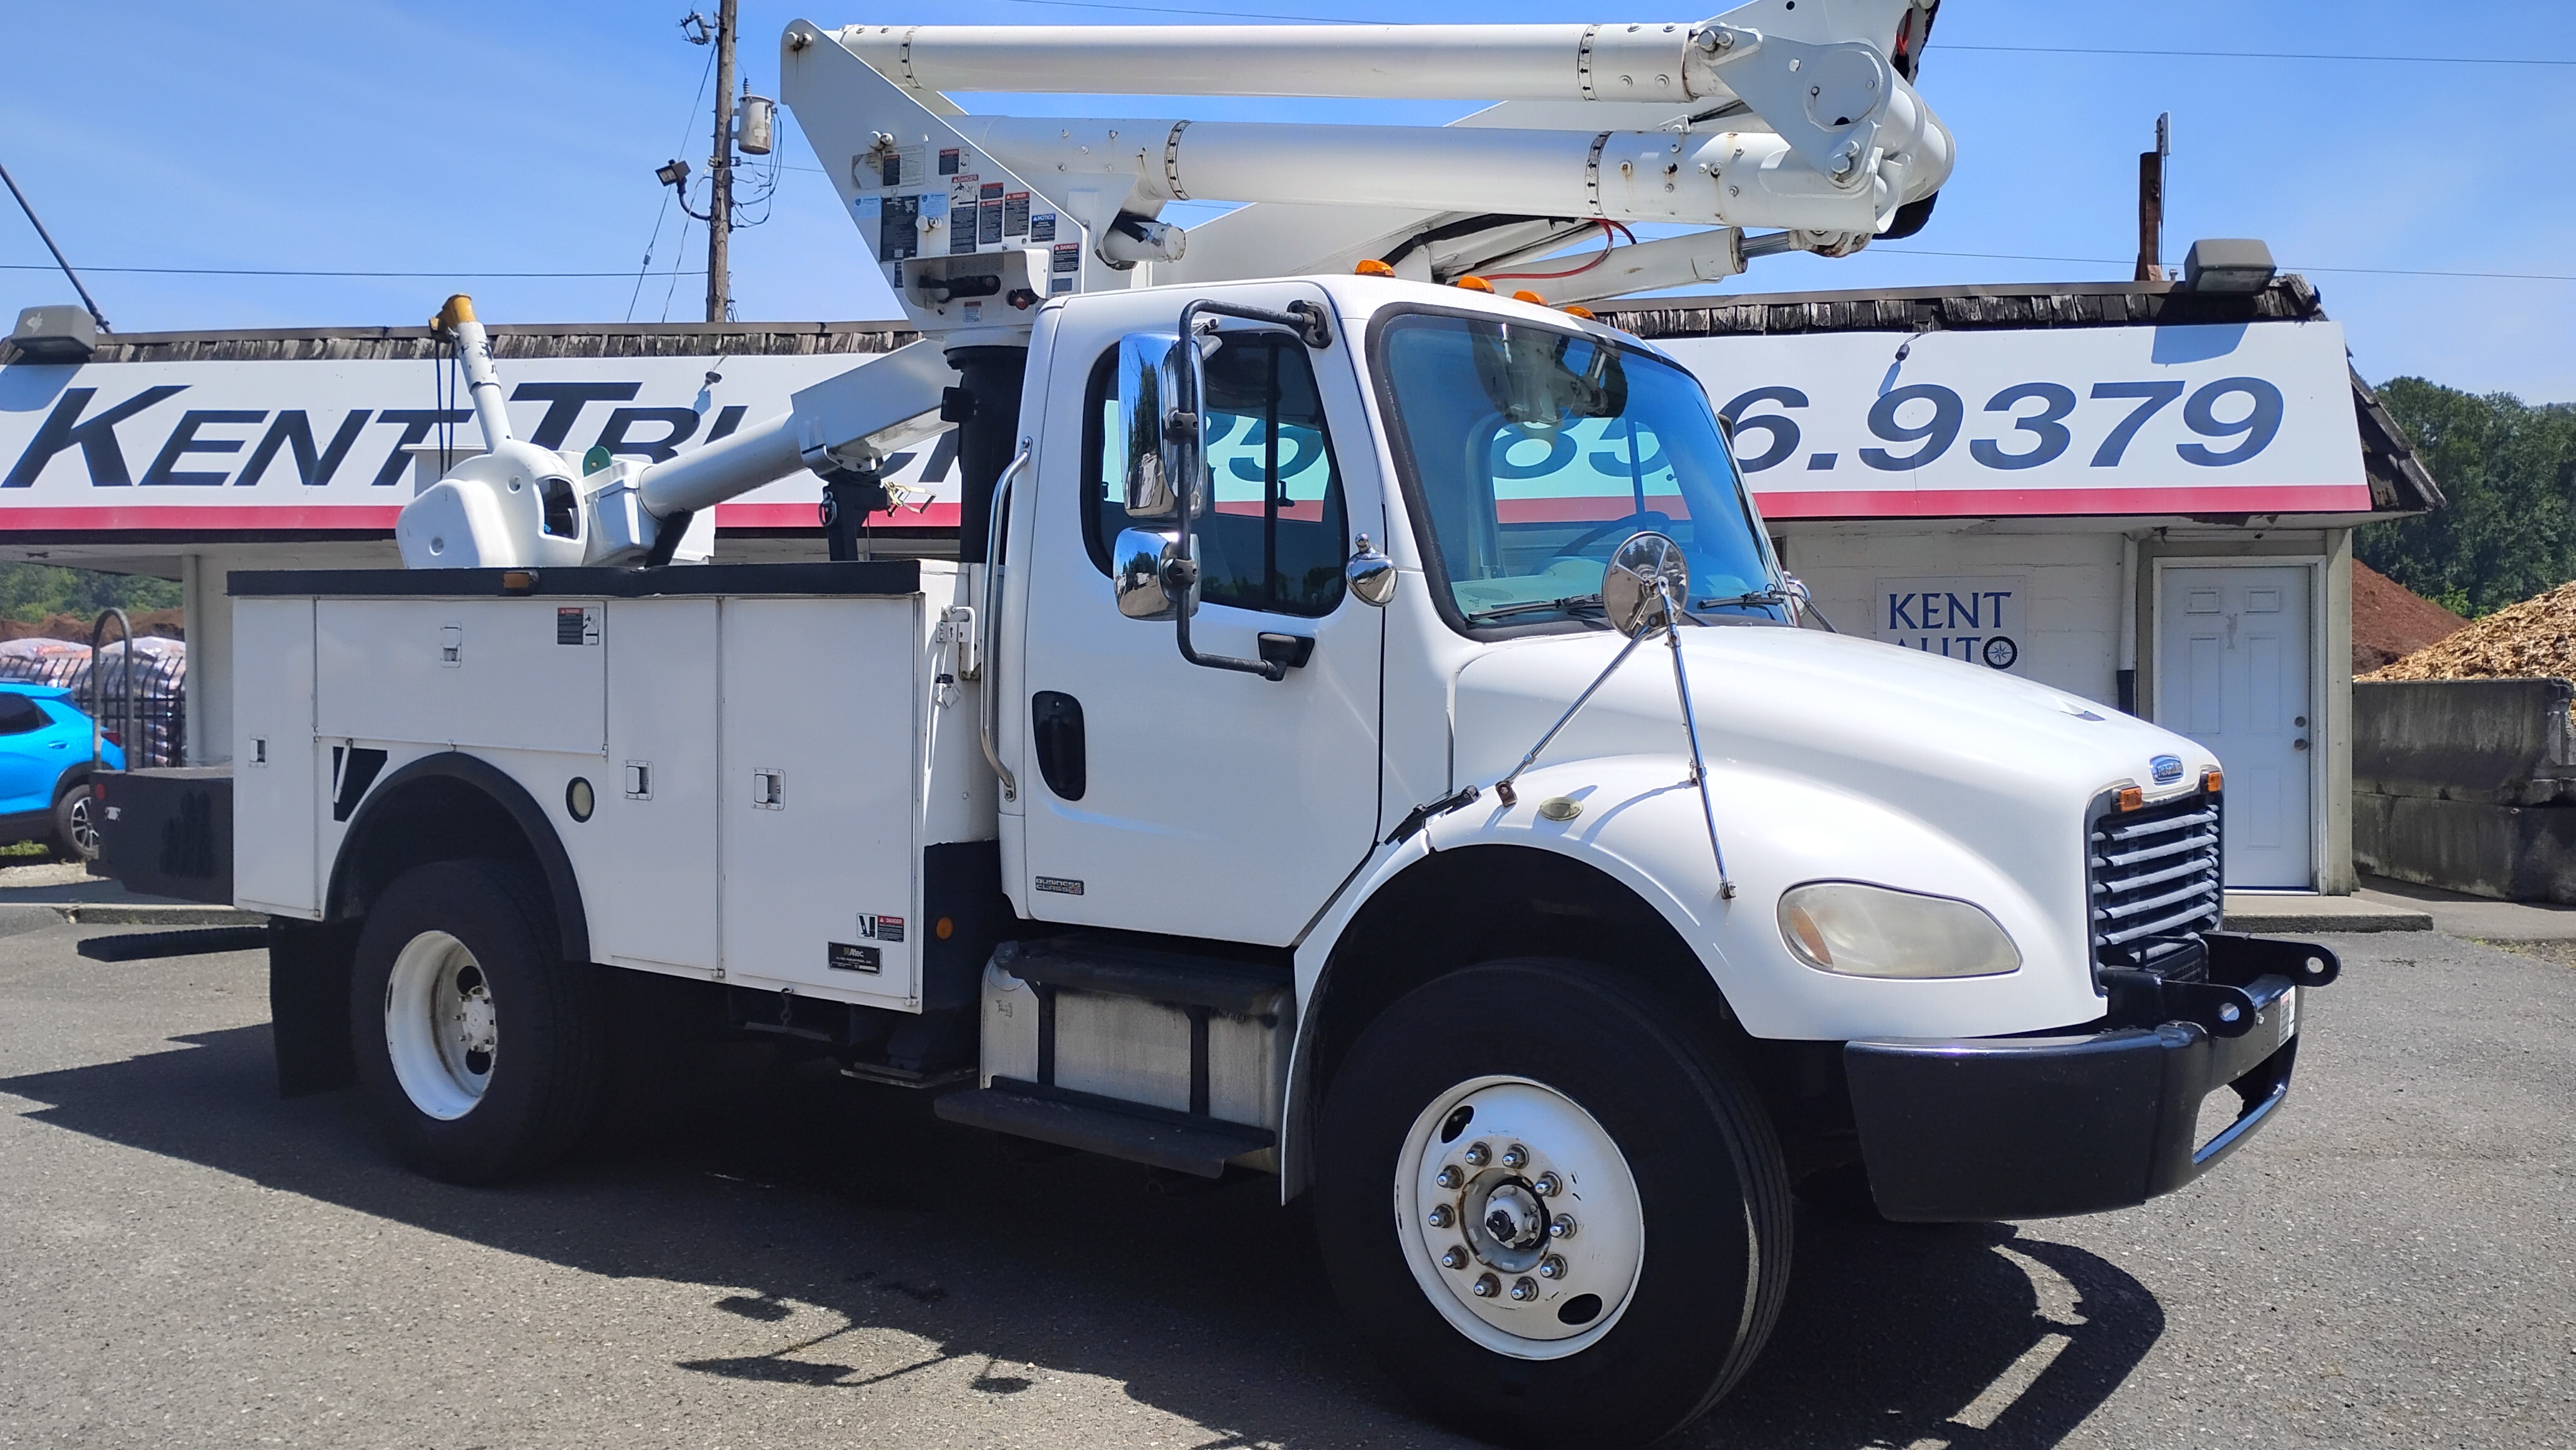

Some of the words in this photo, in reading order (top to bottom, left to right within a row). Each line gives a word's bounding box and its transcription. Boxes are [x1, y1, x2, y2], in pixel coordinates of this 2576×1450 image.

[0, 384, 476, 488] KENT
[1888, 592, 2012, 630] KENT
[1035, 878, 1081, 888] BUSINESS
[849, 948, 864, 957] Altec
